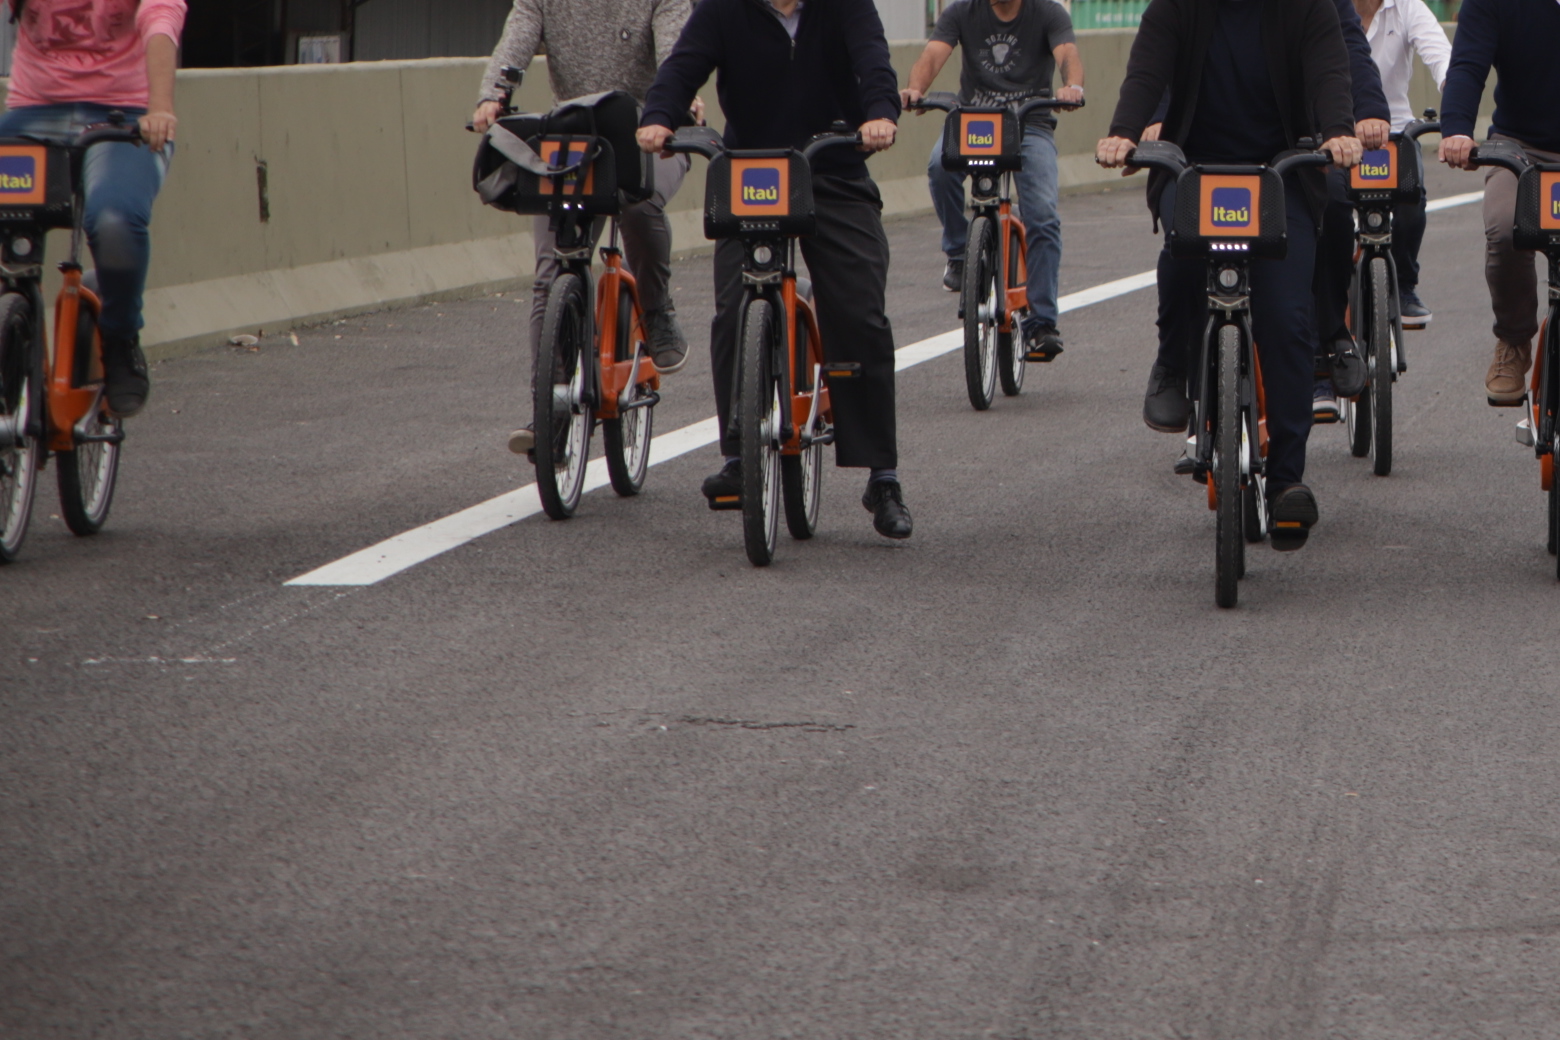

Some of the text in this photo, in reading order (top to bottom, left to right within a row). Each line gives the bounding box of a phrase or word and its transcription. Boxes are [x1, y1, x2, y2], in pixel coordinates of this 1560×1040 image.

[984, 33, 1018, 46] BOXING
[981, 60, 1016, 74] ACADEMY
[967, 133, 993, 145] Itaú
[1360, 162, 1389, 177] Itaú
[744, 184, 777, 201] Itaú
[1213, 205, 1248, 222] Itaú
